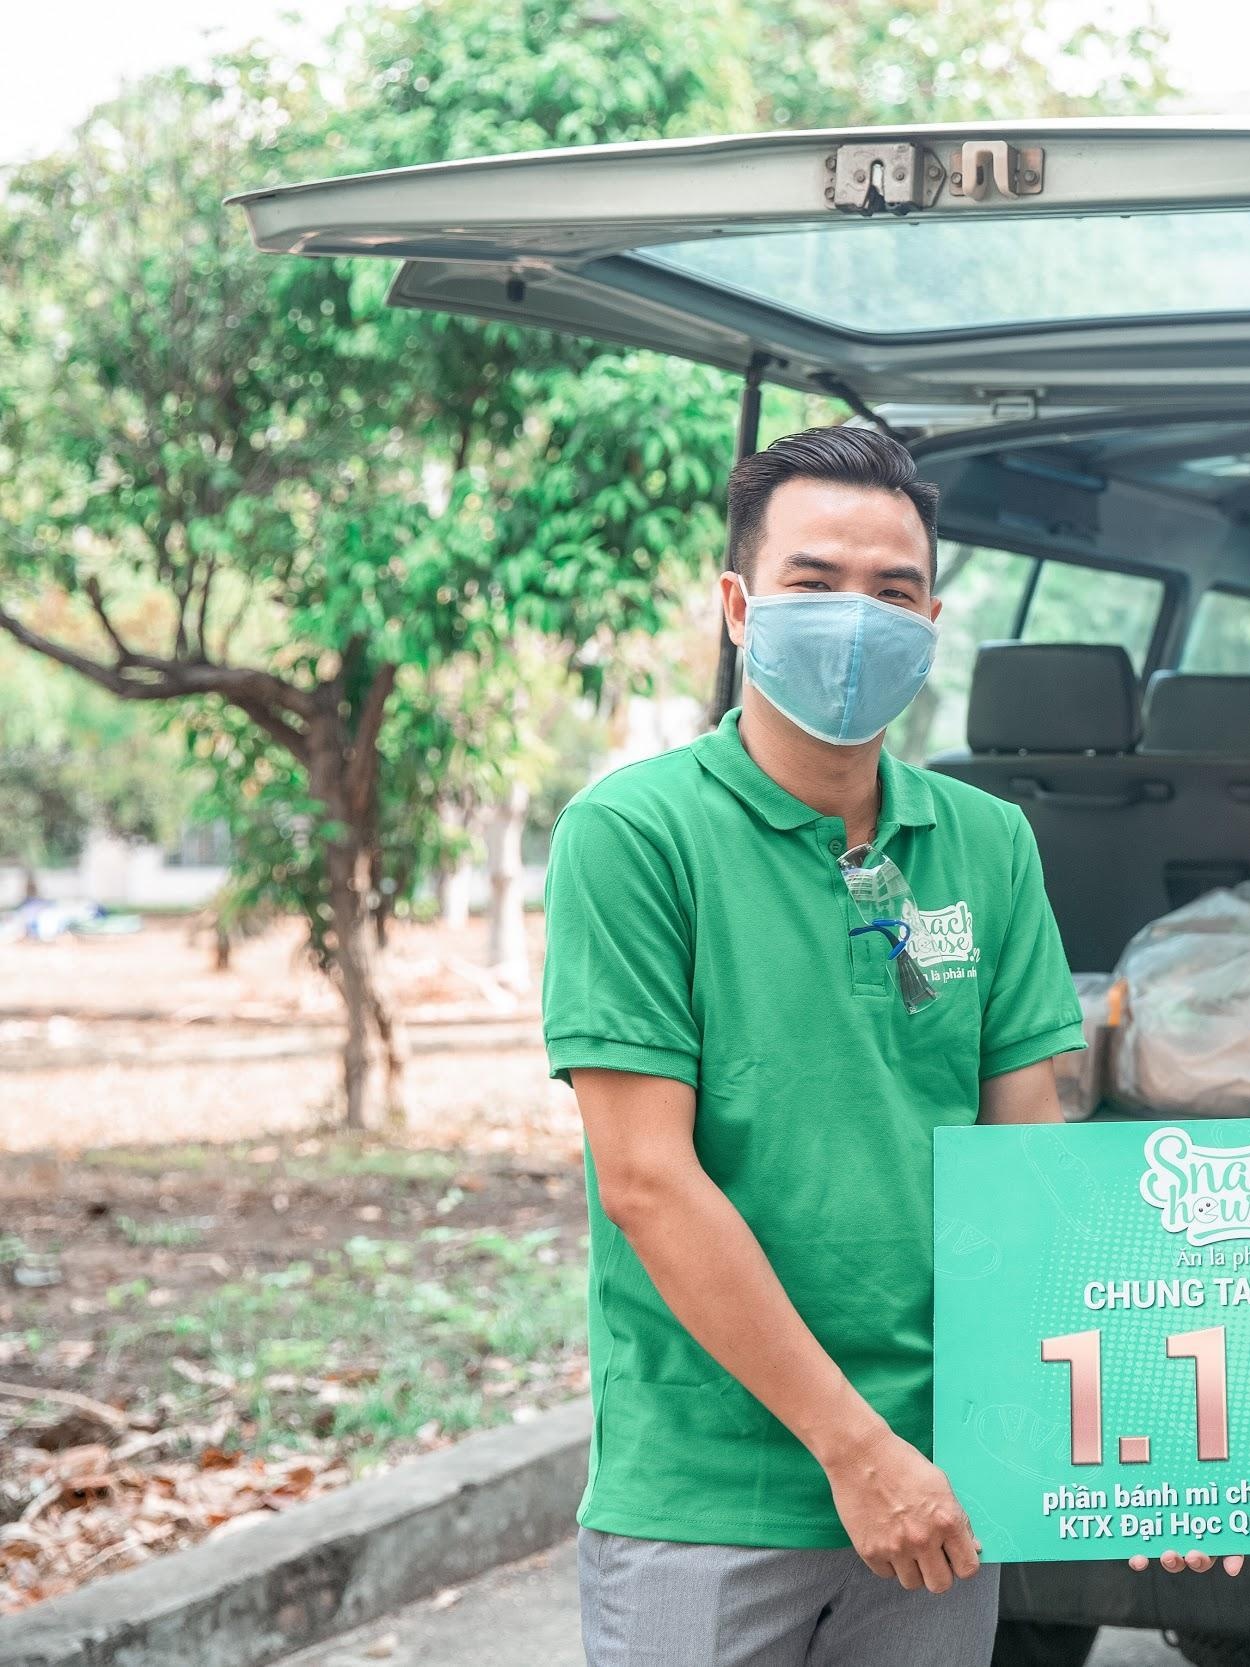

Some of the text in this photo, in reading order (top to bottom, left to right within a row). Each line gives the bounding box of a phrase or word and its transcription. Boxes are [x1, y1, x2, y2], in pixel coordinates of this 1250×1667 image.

[1176, 1247, 1203, 1267] Ăn
[1209, 1246, 1226, 1266] là
[1083, 1278, 1205, 1310] CHUNG
[1042, 1482, 1108, 1516] phần
[1114, 1482, 1179, 1508] bánh
[1185, 1481, 1219, 1505] mì
[1059, 1514, 1114, 1539] KTX
[1119, 1511, 1163, 1541] Đại
[1170, 1511, 1222, 1540] Học
